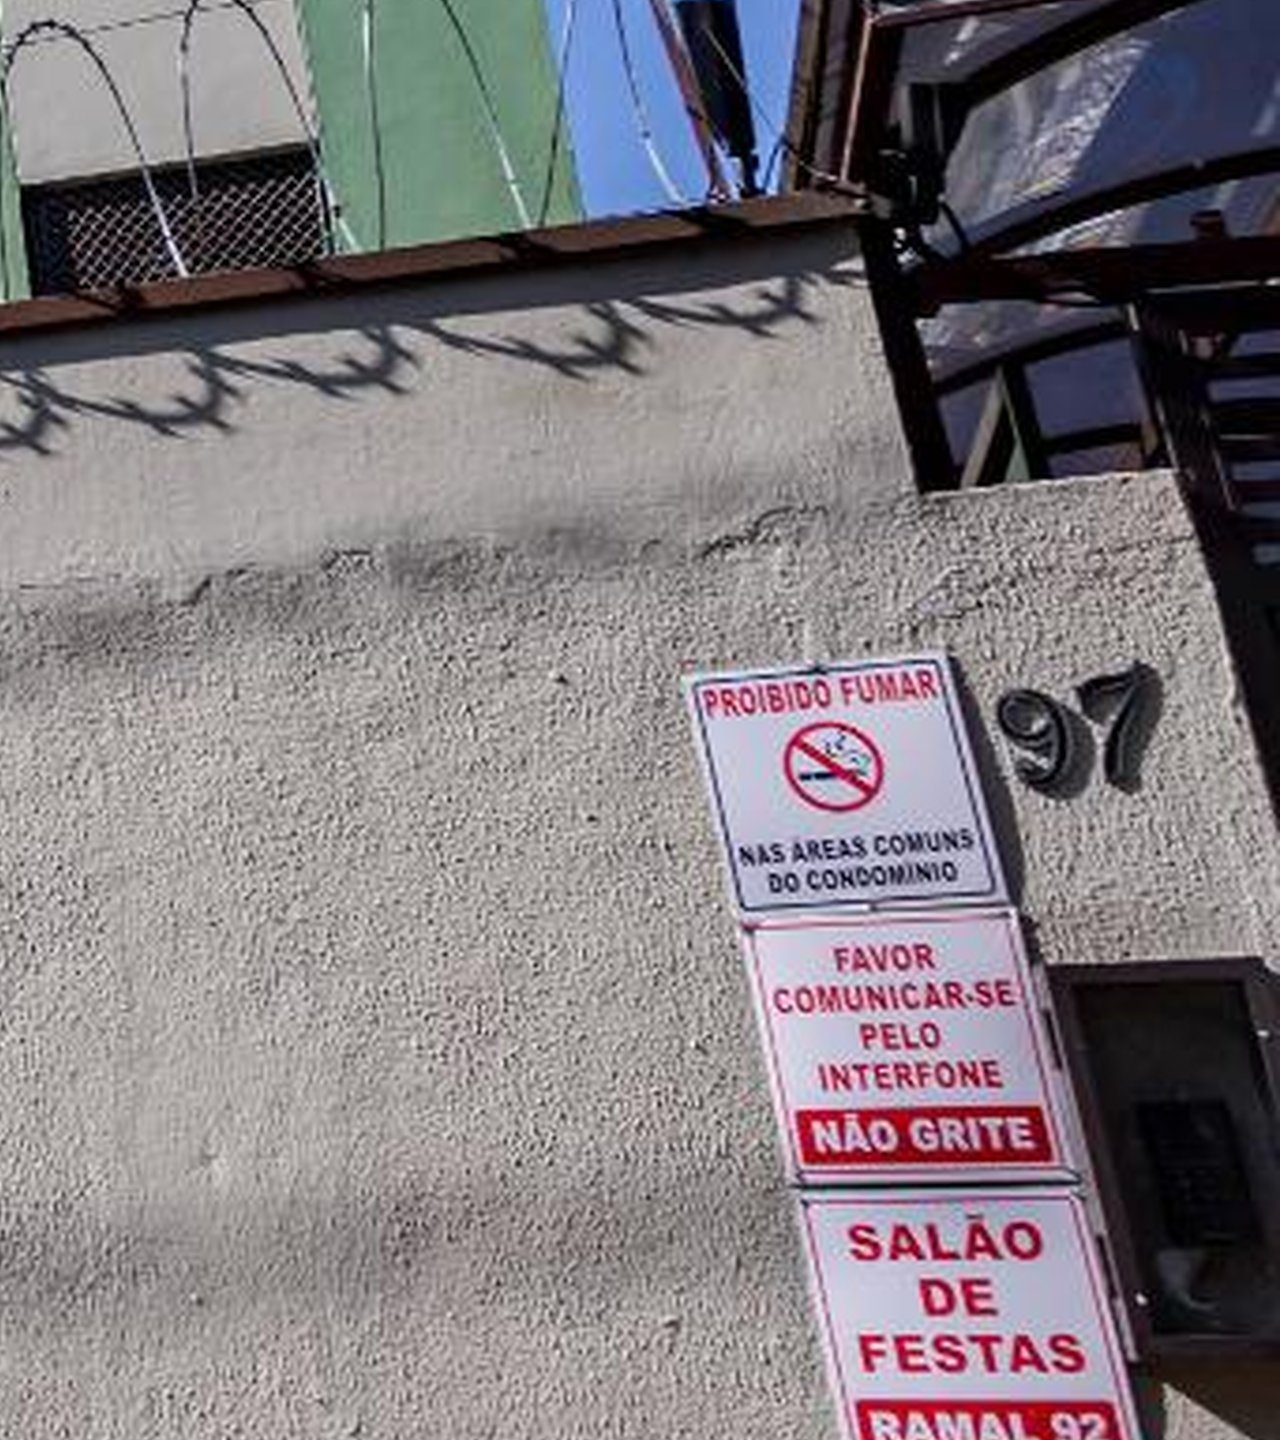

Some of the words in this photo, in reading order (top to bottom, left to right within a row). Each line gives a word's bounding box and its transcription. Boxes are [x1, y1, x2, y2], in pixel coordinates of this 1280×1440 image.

[702, 679, 832, 717] PROIBIDO
[839, 669, 938, 706] FUMAR
[998, 661, 1161, 797] 97
[739, 843, 786, 867] NAS
[873, 827, 975, 856] COMUNS
[768, 871, 800, 893] DO
[833, 943, 936, 972] FAVOR
[773, 979, 1016, 1014] COMUNICAR-SE
[860, 1022, 942, 1050] PELO
[818, 1060, 1004, 1092] INTERFONE
[811, 1112, 898, 1154] NÃO
[908, 1116, 1036, 1151] GRITE
[847, 1213, 1044, 1261] SALÃO
[918, 1277, 999, 1317] DE
[857, 1333, 1086, 1374] FESTAS
